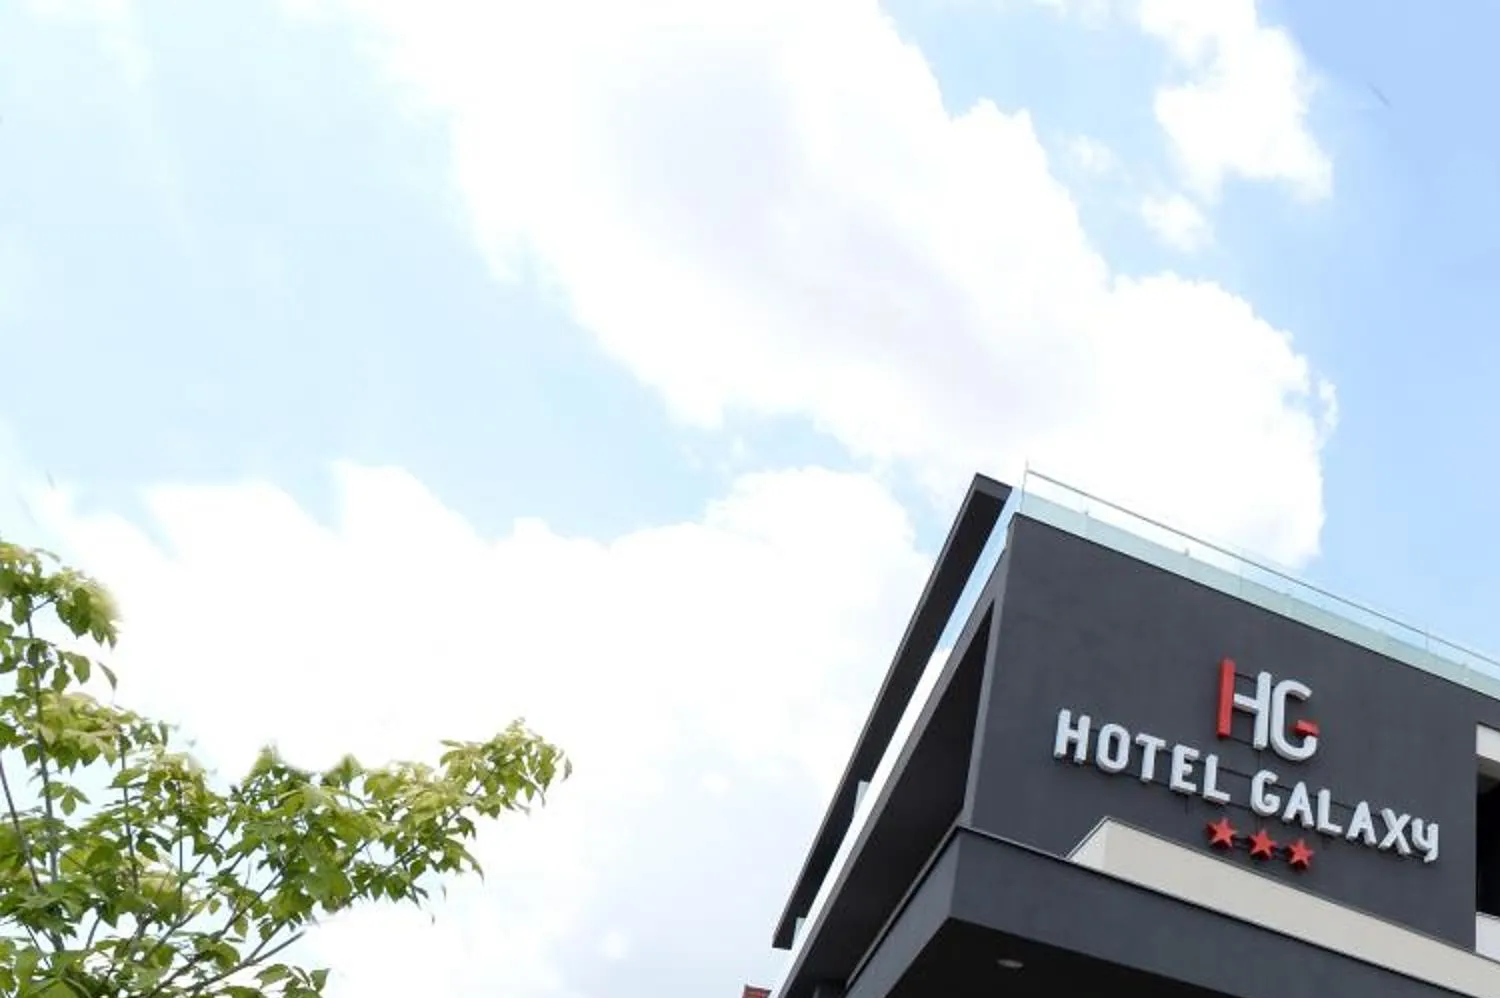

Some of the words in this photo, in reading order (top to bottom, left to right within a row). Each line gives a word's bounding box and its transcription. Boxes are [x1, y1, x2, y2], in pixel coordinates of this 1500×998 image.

[1216, 656, 1321, 762] HG
[1053, 708, 1231, 804] HOTEL
[1249, 768, 1441, 864] GALAXY
